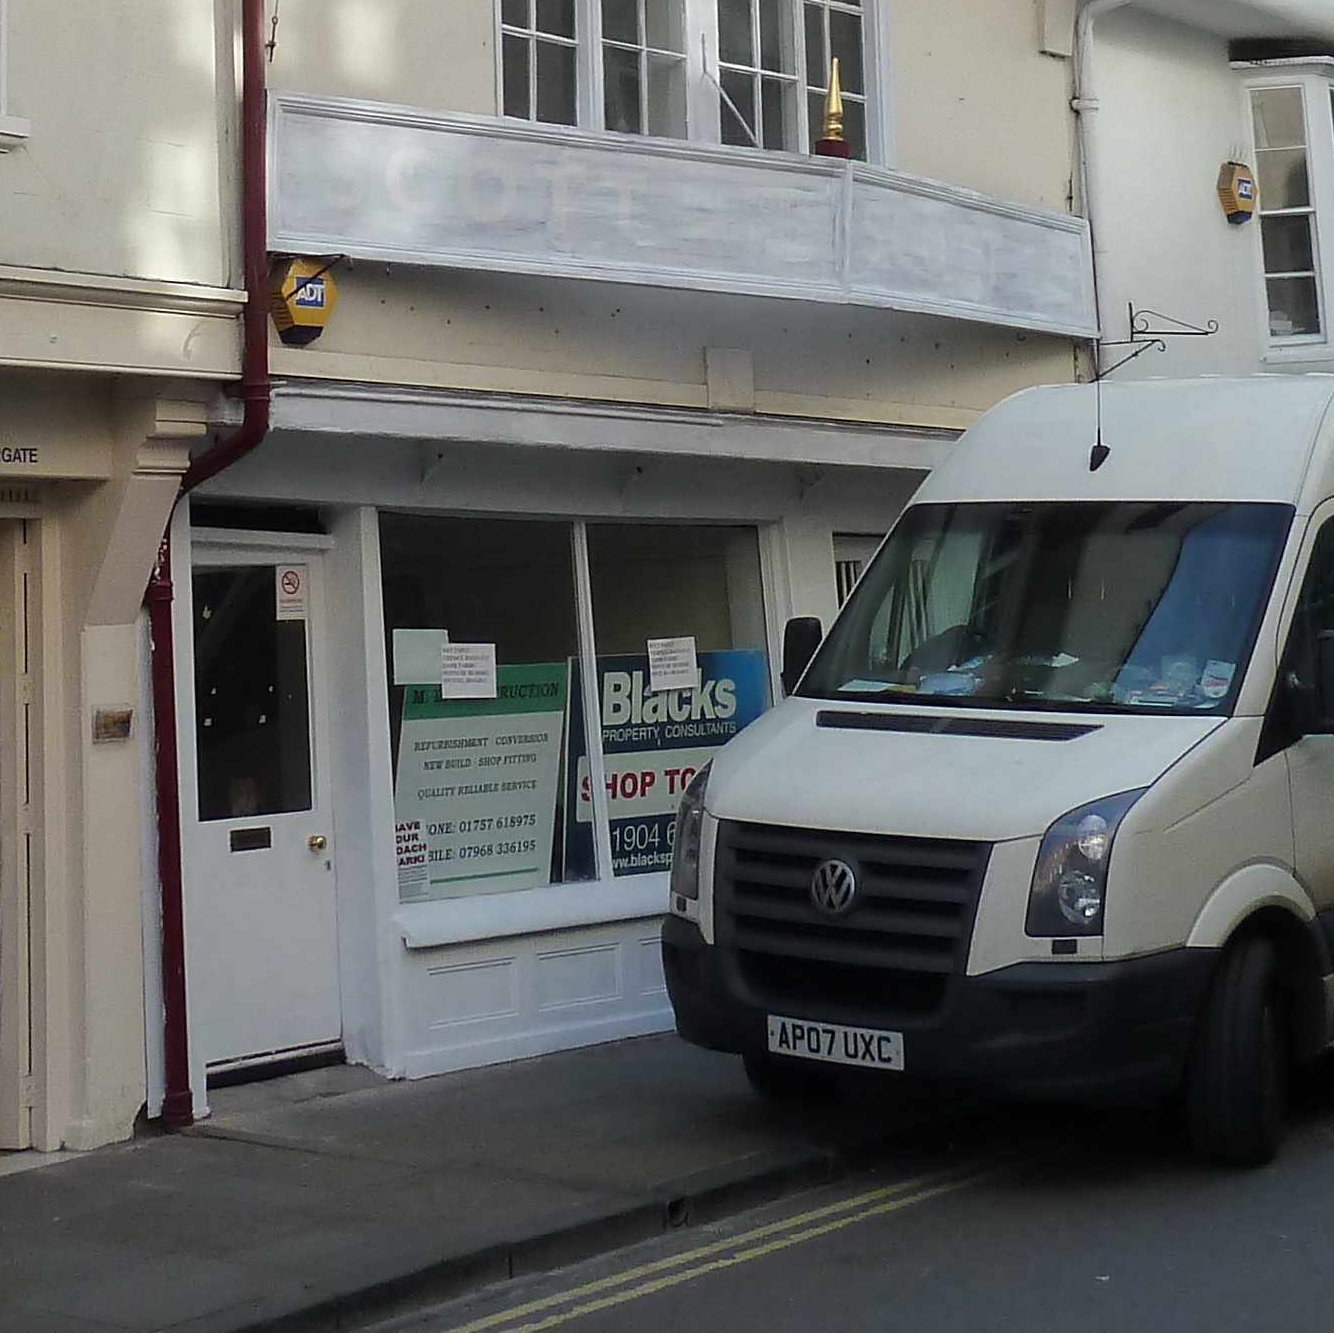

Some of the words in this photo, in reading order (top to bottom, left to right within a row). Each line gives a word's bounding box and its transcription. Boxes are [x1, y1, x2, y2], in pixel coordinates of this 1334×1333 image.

[296, 283, 326, 302] ADT
[603, 667, 738, 726] Blacks
[603, 726, 660, 742] PROPERTY
[665, 722, 737, 739] CONSULTANTS
[414, 737, 489, 752] REFURBISHMENT
[495, 733, 549, 746] CONVERSION
[423, 760, 444, 771] NEW
[445, 758, 472, 770] BUILD
[478, 755, 502, 768] SHOP
[503, 752, 537, 765] FITTING
[418, 787, 455, 801] QUALITY
[457, 783, 499, 796] RELIABLE
[501, 779, 537, 792] SERVICE
[395, 821, 420, 833] AVE
[427, 822, 456, 836] ONE:
[459, 818, 494, 834] 01757
[496, 814, 536, 830] 618975
[396, 843, 427, 855] OACH
[428, 848, 456, 863] BILE:
[459, 843, 493, 859] 07968
[496, 839, 536, 856] 336195
[778, 1021, 836, 1056] AP07
[843, 1030, 892, 1063] UXC
